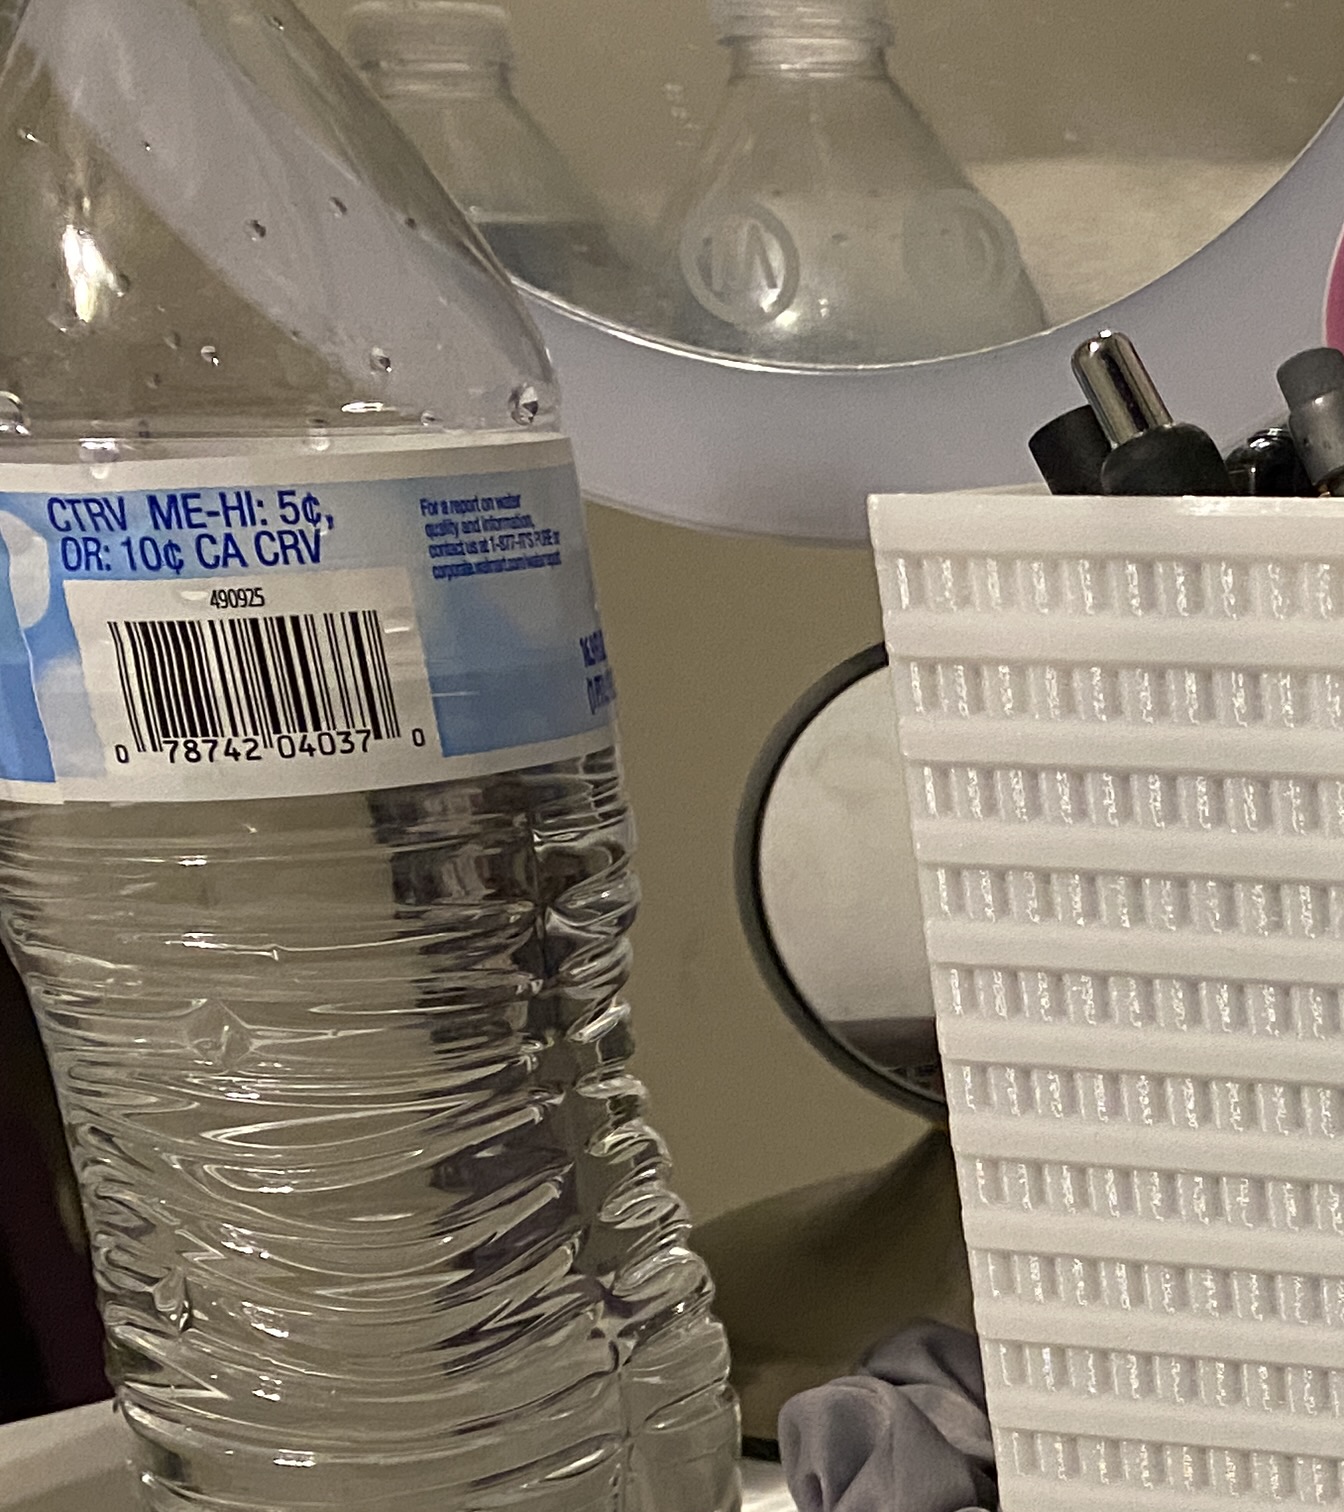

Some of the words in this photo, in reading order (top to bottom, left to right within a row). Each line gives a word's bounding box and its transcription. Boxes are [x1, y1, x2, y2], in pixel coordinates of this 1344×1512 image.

[47, 496, 127, 532] CTRV
[146, 490, 268, 531] ME-HI:
[277, 489, 335, 531] 5¢,
[60, 537, 111, 572] OR:
[121, 536, 185, 574] 10¢
[195, 533, 249, 570] CA
[254, 528, 322, 566] CRV
[210, 587, 265, 609] 490925
[163, 738, 262, 764] 78742
[277, 729, 371, 759] 04037
[412, 727, 425, 747] 0
